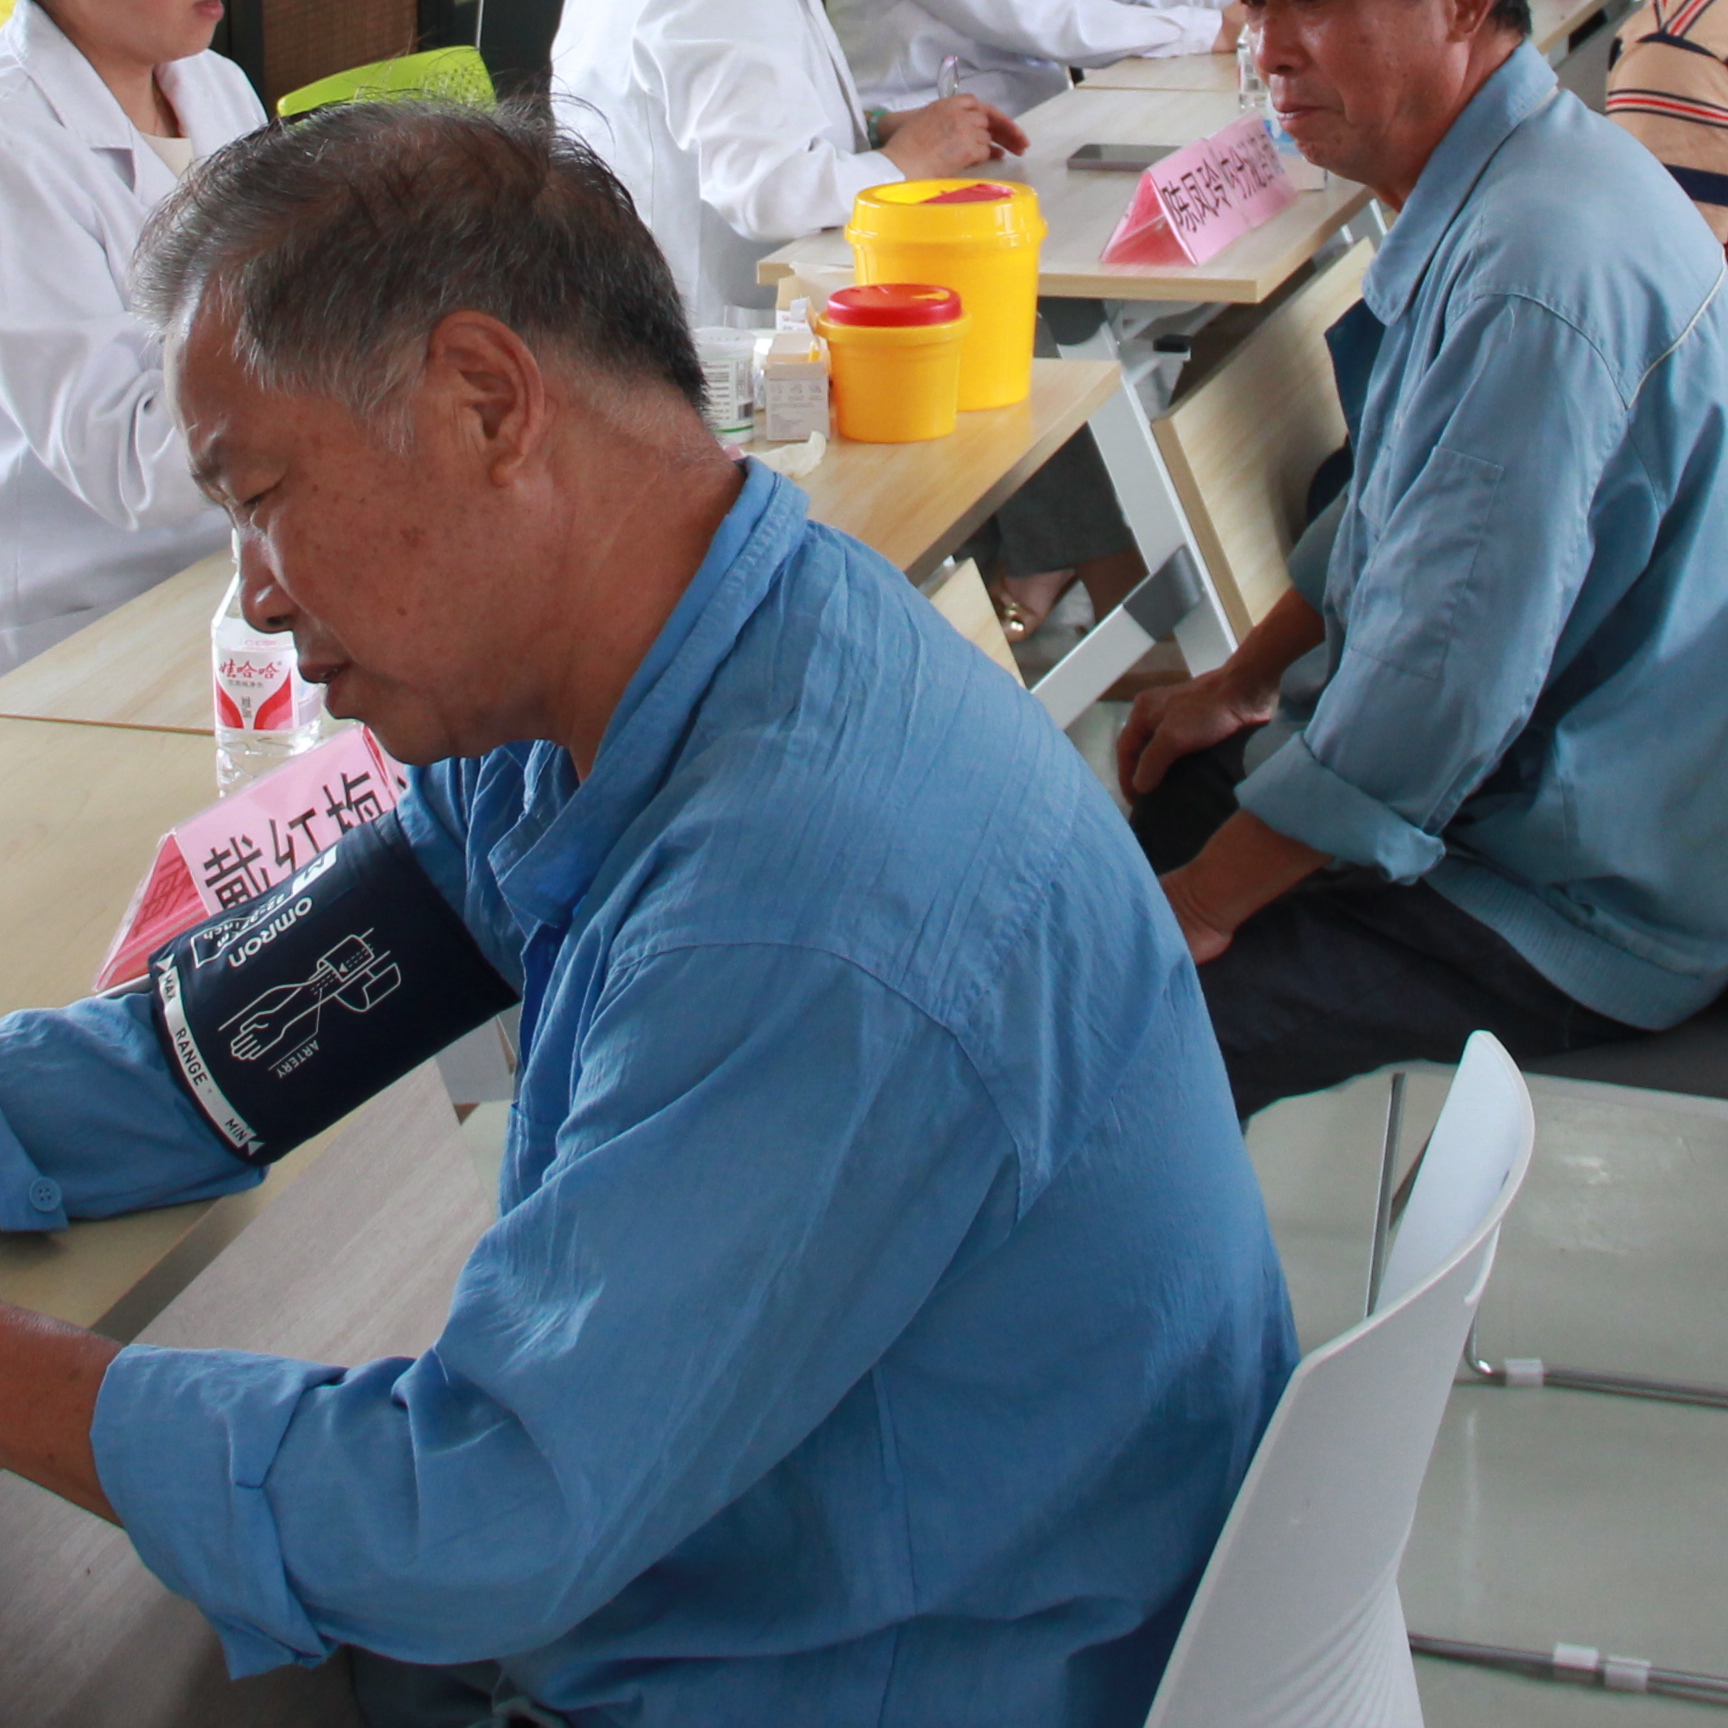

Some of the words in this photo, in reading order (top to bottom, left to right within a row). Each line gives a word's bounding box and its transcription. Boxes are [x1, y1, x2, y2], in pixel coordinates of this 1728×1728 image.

[1161, 157, 1232, 233] 陈凤玲
[218, 659, 280, 680] 娃哈哈
[203, 771, 383, 910] 戴红梅
[227, 896, 314, 969] OMRON
[175, 1027, 208, 1087] RANGE
[275, 1039, 320, 1079] ARTERY
[224, 1117, 248, 1142] MIN
